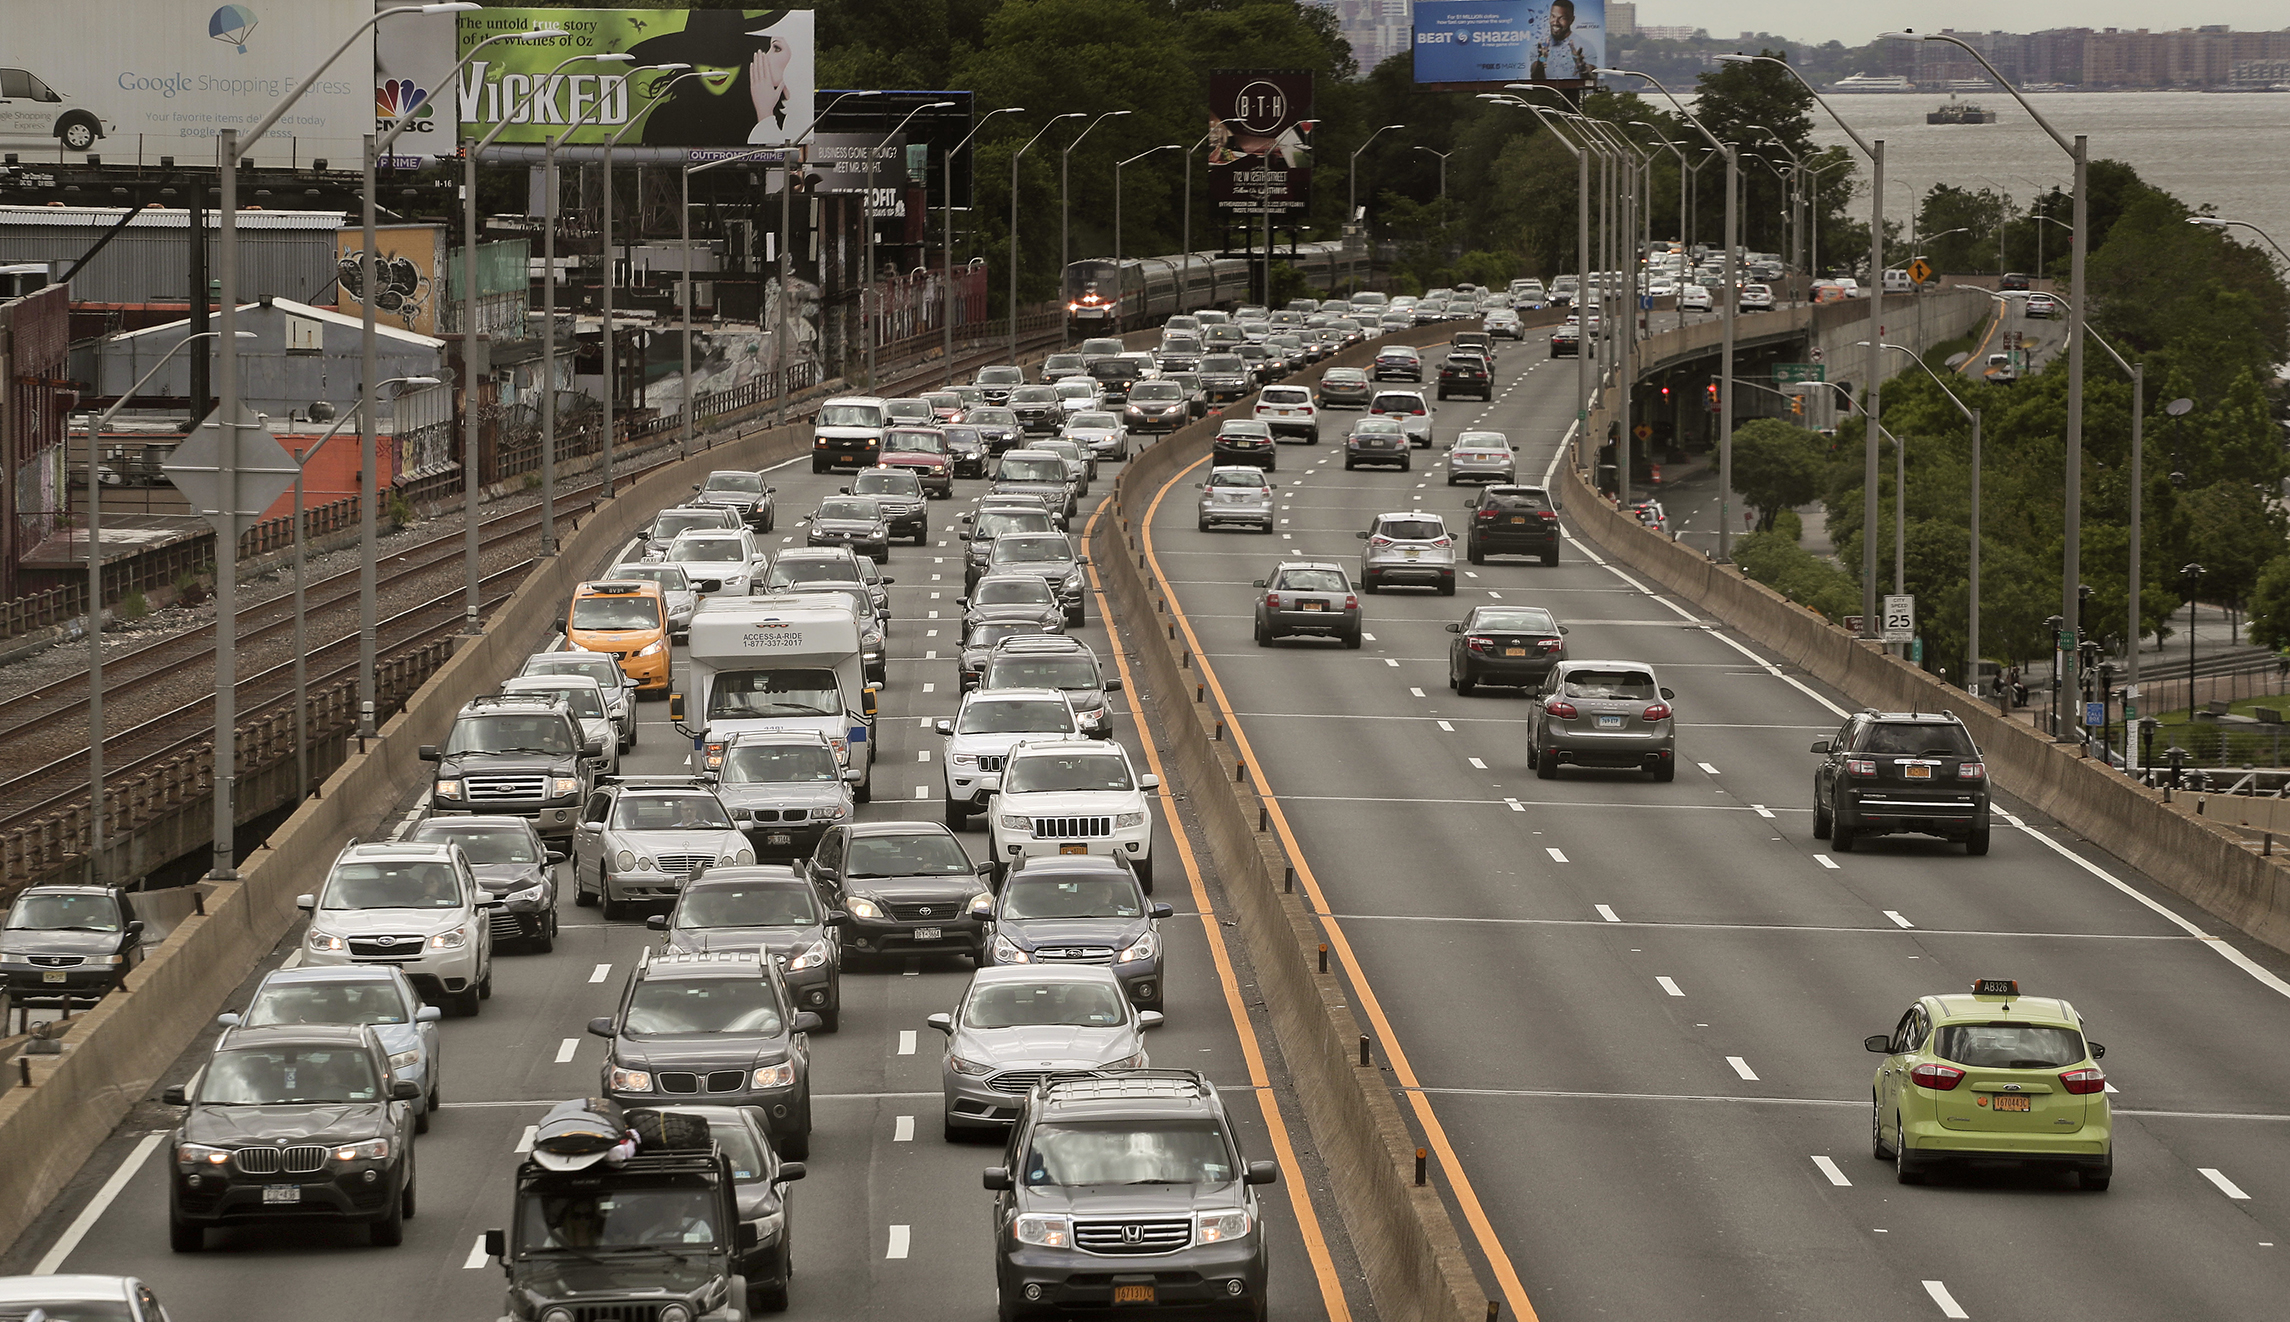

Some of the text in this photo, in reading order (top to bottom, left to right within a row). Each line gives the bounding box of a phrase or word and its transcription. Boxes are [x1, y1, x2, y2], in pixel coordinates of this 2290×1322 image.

[459, 17, 597, 32] The untold true story
[463, 35, 478, 45] of
[480, 34, 500, 46] the
[560, 36, 572, 46] of
[576, 36, 594, 46] Oz
[118, 72, 351, 98] Google Shopping Epress
[14, 112, 52, 122] Shopping
[146, 112, 170, 122] Your
[172, 112, 212, 122] favorite
[215, 113, 244, 123] items
[296, 116, 326, 127] today
[14, 122, 46, 130] Express
[818, 146, 847, 158] BUSINESS
[848, 147, 867, 158] GONE
[380, 160, 418, 168] PRIME
[833, 162, 848, 172] MEET
[850, 162, 861, 172] MR.
[1243, 171, 1250, 182] W
[1266, 171, 1288, 182] STREET
[1889, 615, 1910, 627] 25
[1984, 982, 2008, 992] AB326
